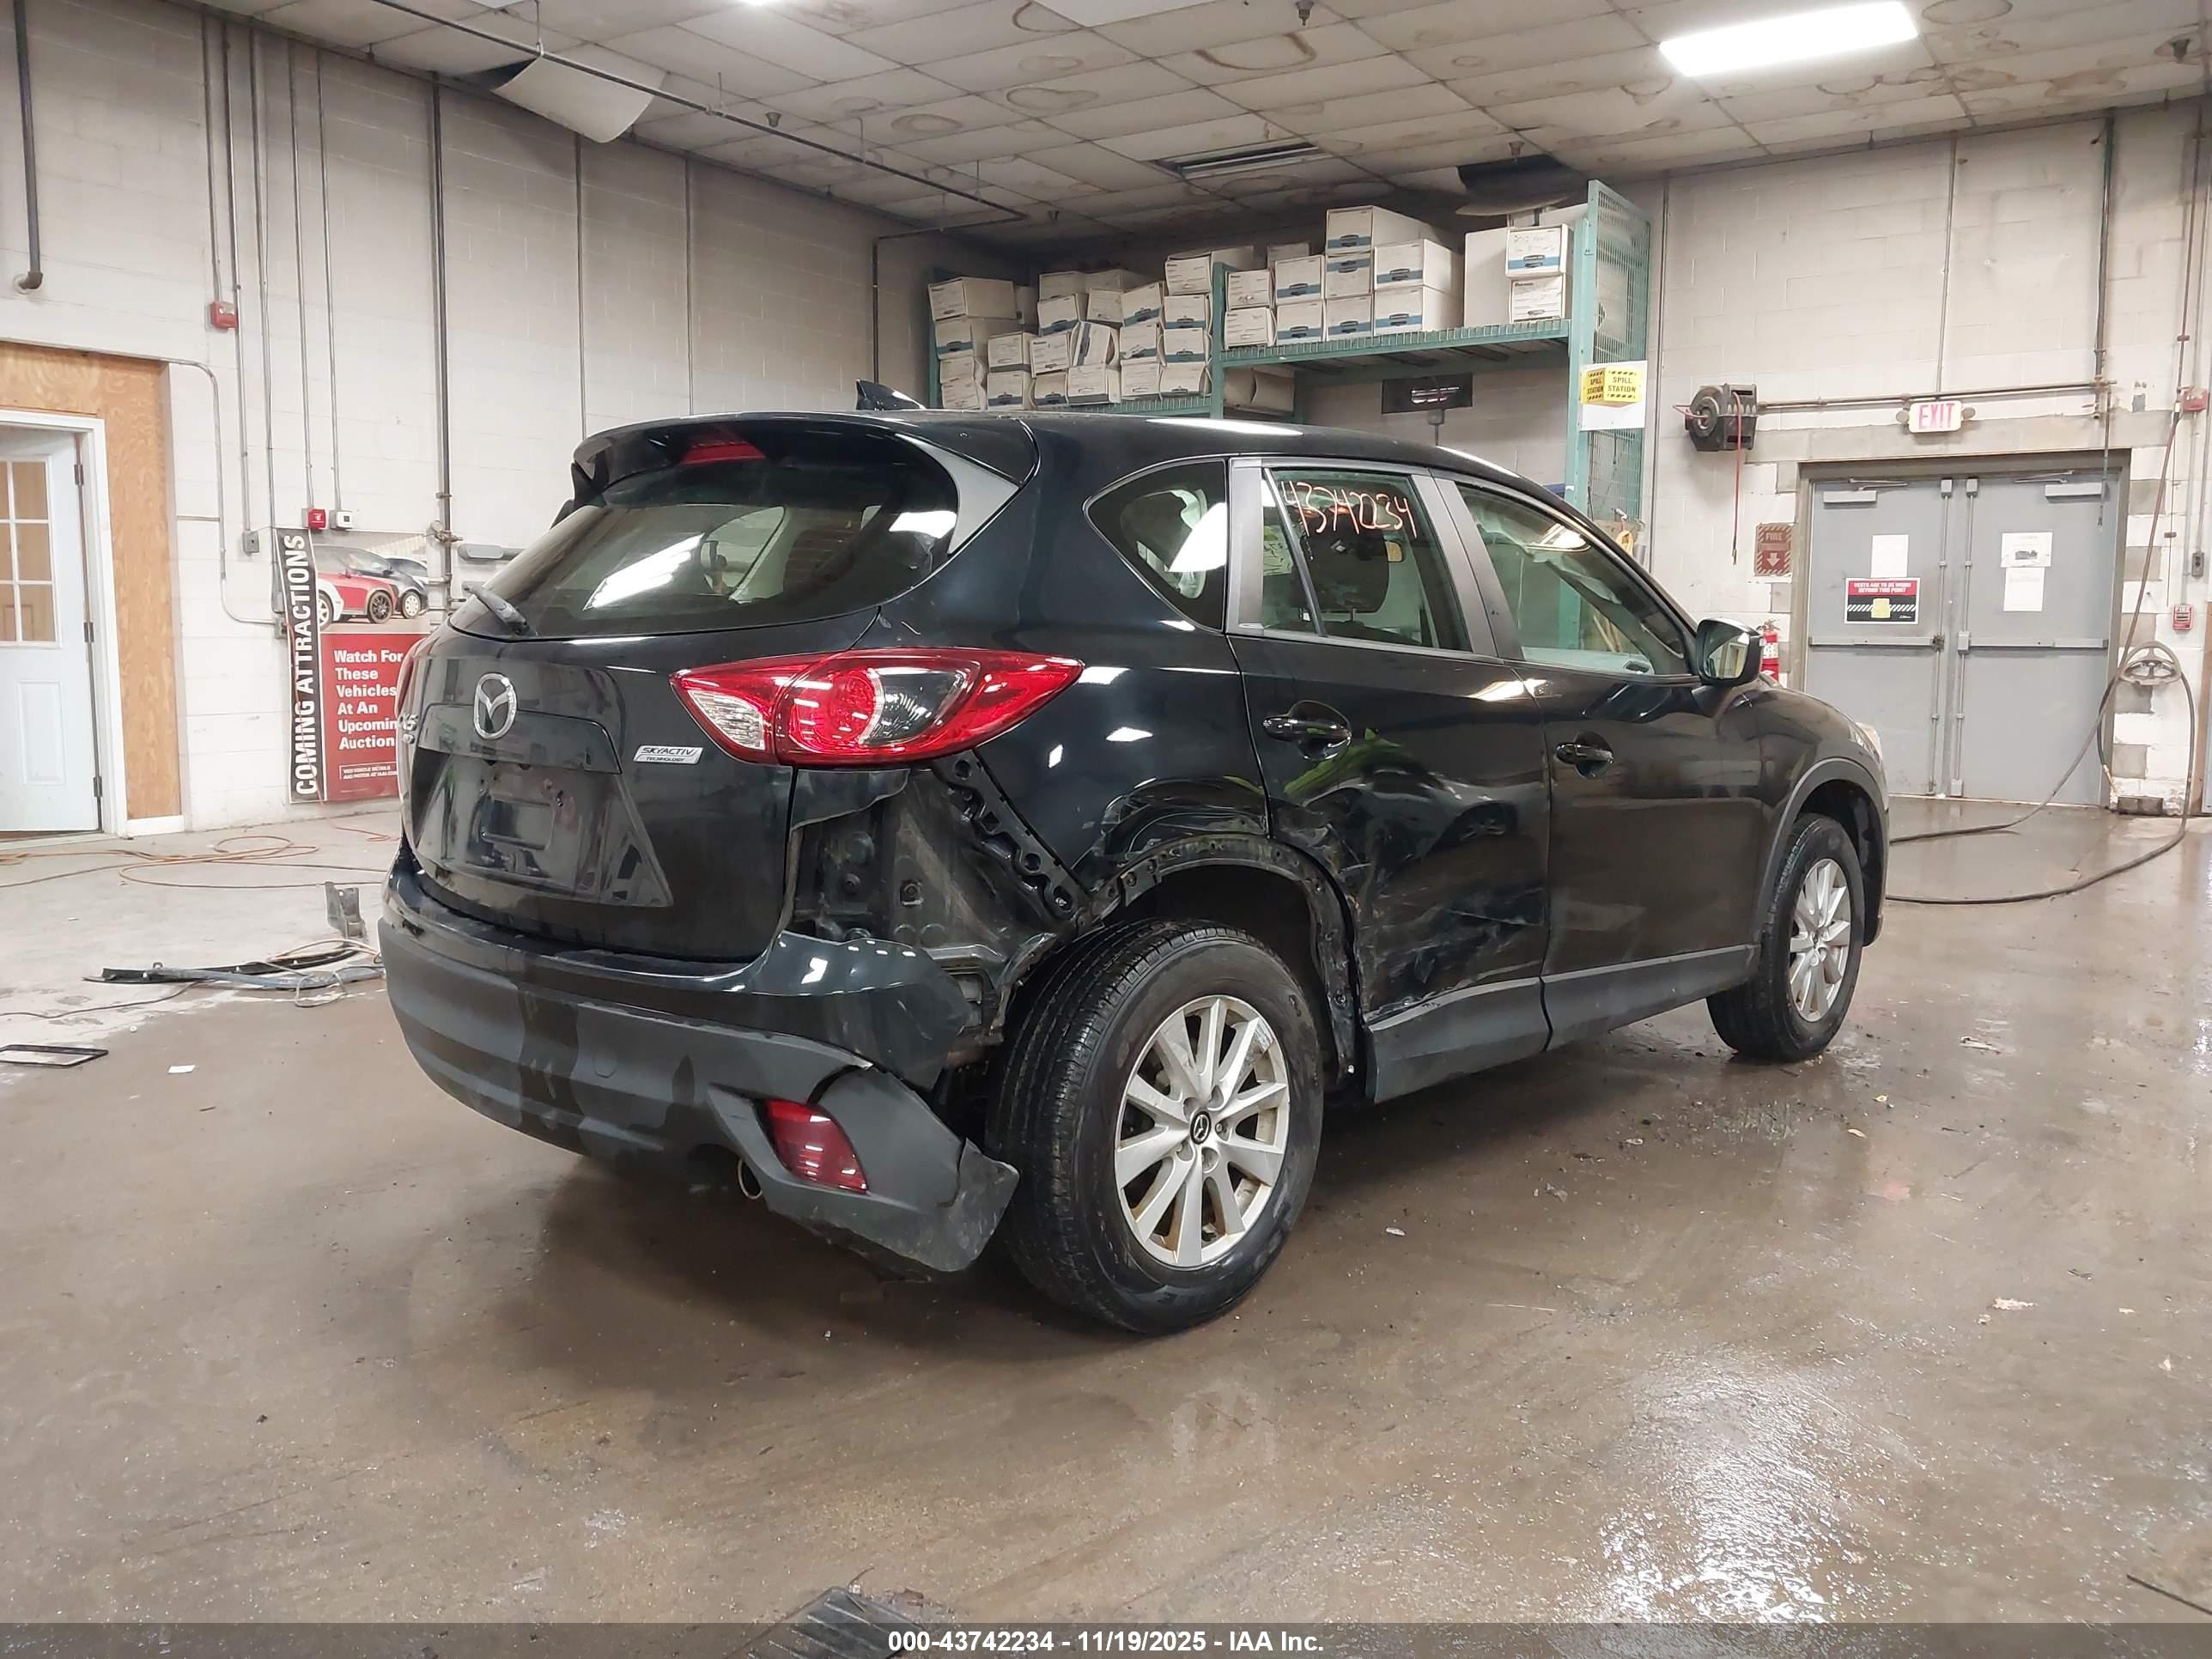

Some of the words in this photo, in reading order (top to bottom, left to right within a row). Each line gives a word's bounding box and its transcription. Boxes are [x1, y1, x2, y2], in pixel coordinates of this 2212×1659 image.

[1607, 385, 1637, 393] STATION
[1918, 403, 1955, 429] EXIT
[284, 535, 314, 695] ATTRACTIONS
[334, 650, 378, 663] Watch
[380, 650, 404, 663] For
[335, 667, 379, 681] These
[336, 684, 397, 698] Vehicles
[337, 702, 354, 715] At
[356, 701, 379, 714] An
[337, 718, 398, 735] Upcomin
[295, 701, 318, 795] COMING
[641, 747, 695, 756] SKYACTIV
